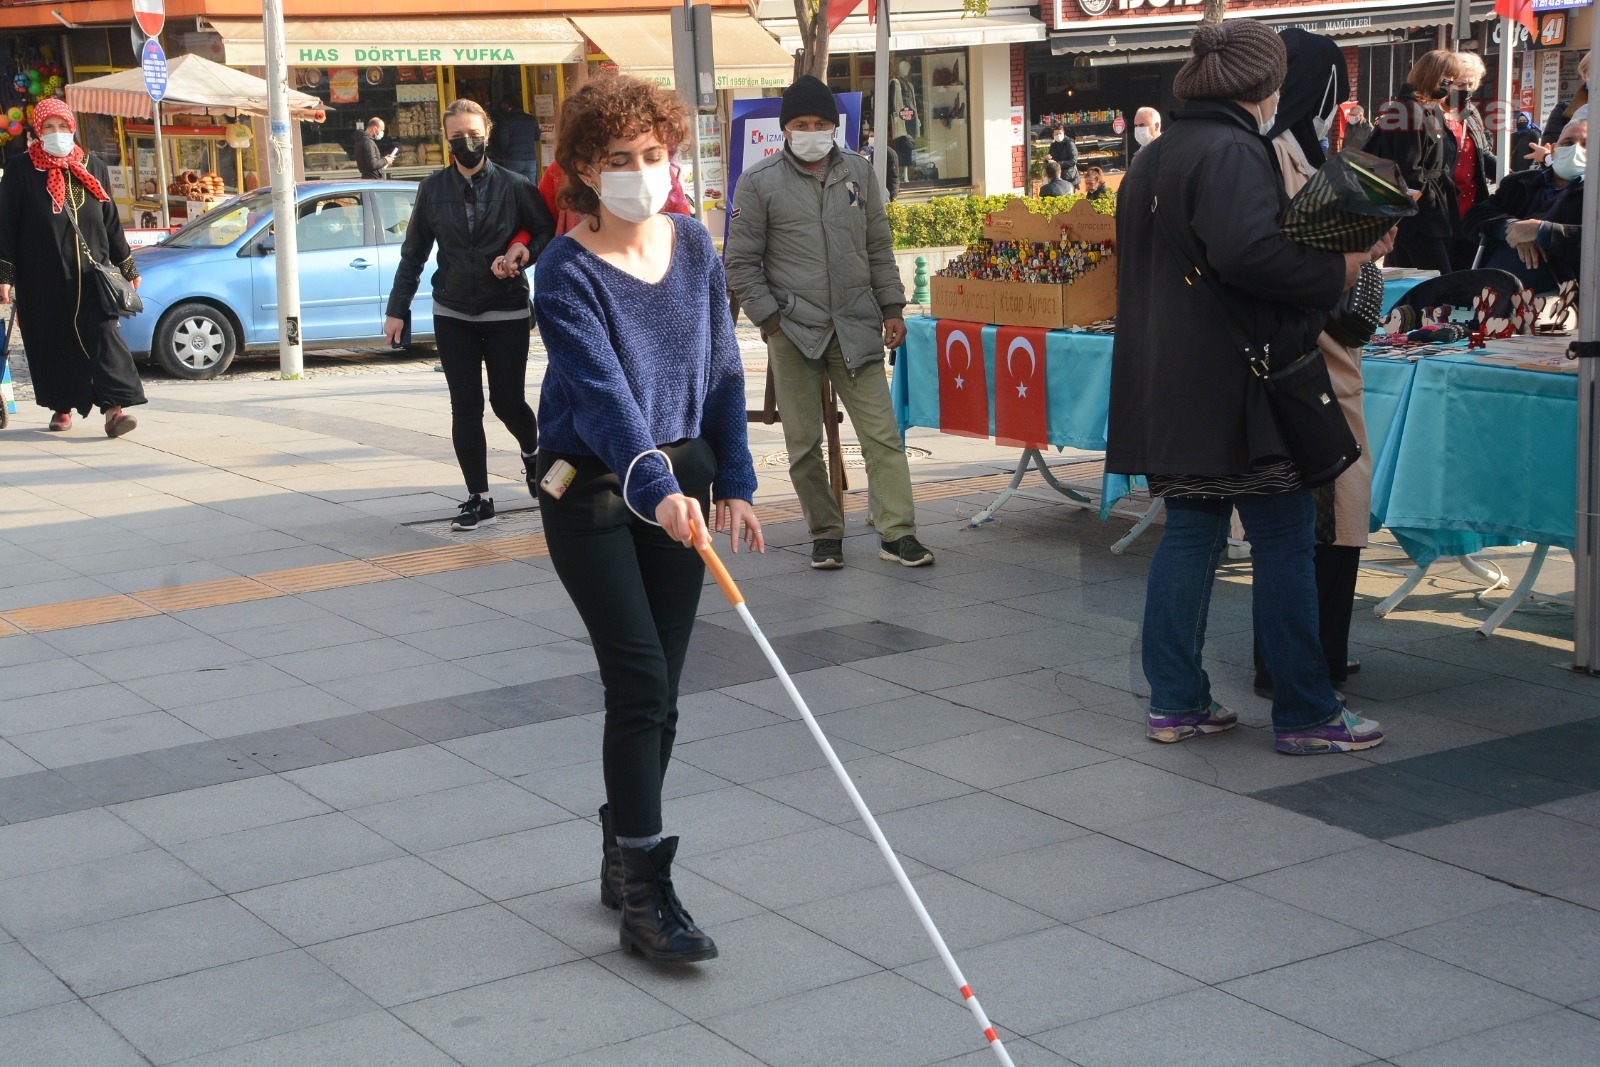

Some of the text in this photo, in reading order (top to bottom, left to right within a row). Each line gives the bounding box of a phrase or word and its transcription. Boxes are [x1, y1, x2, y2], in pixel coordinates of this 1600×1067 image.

[1325, 17, 1371, 32] MAMÜLLERİ
[1541, 17, 1563, 43] 41
[299, 45, 515, 62] HAS DÖRTLER YUFKA
[1000, 291, 1024, 314] Kitap
